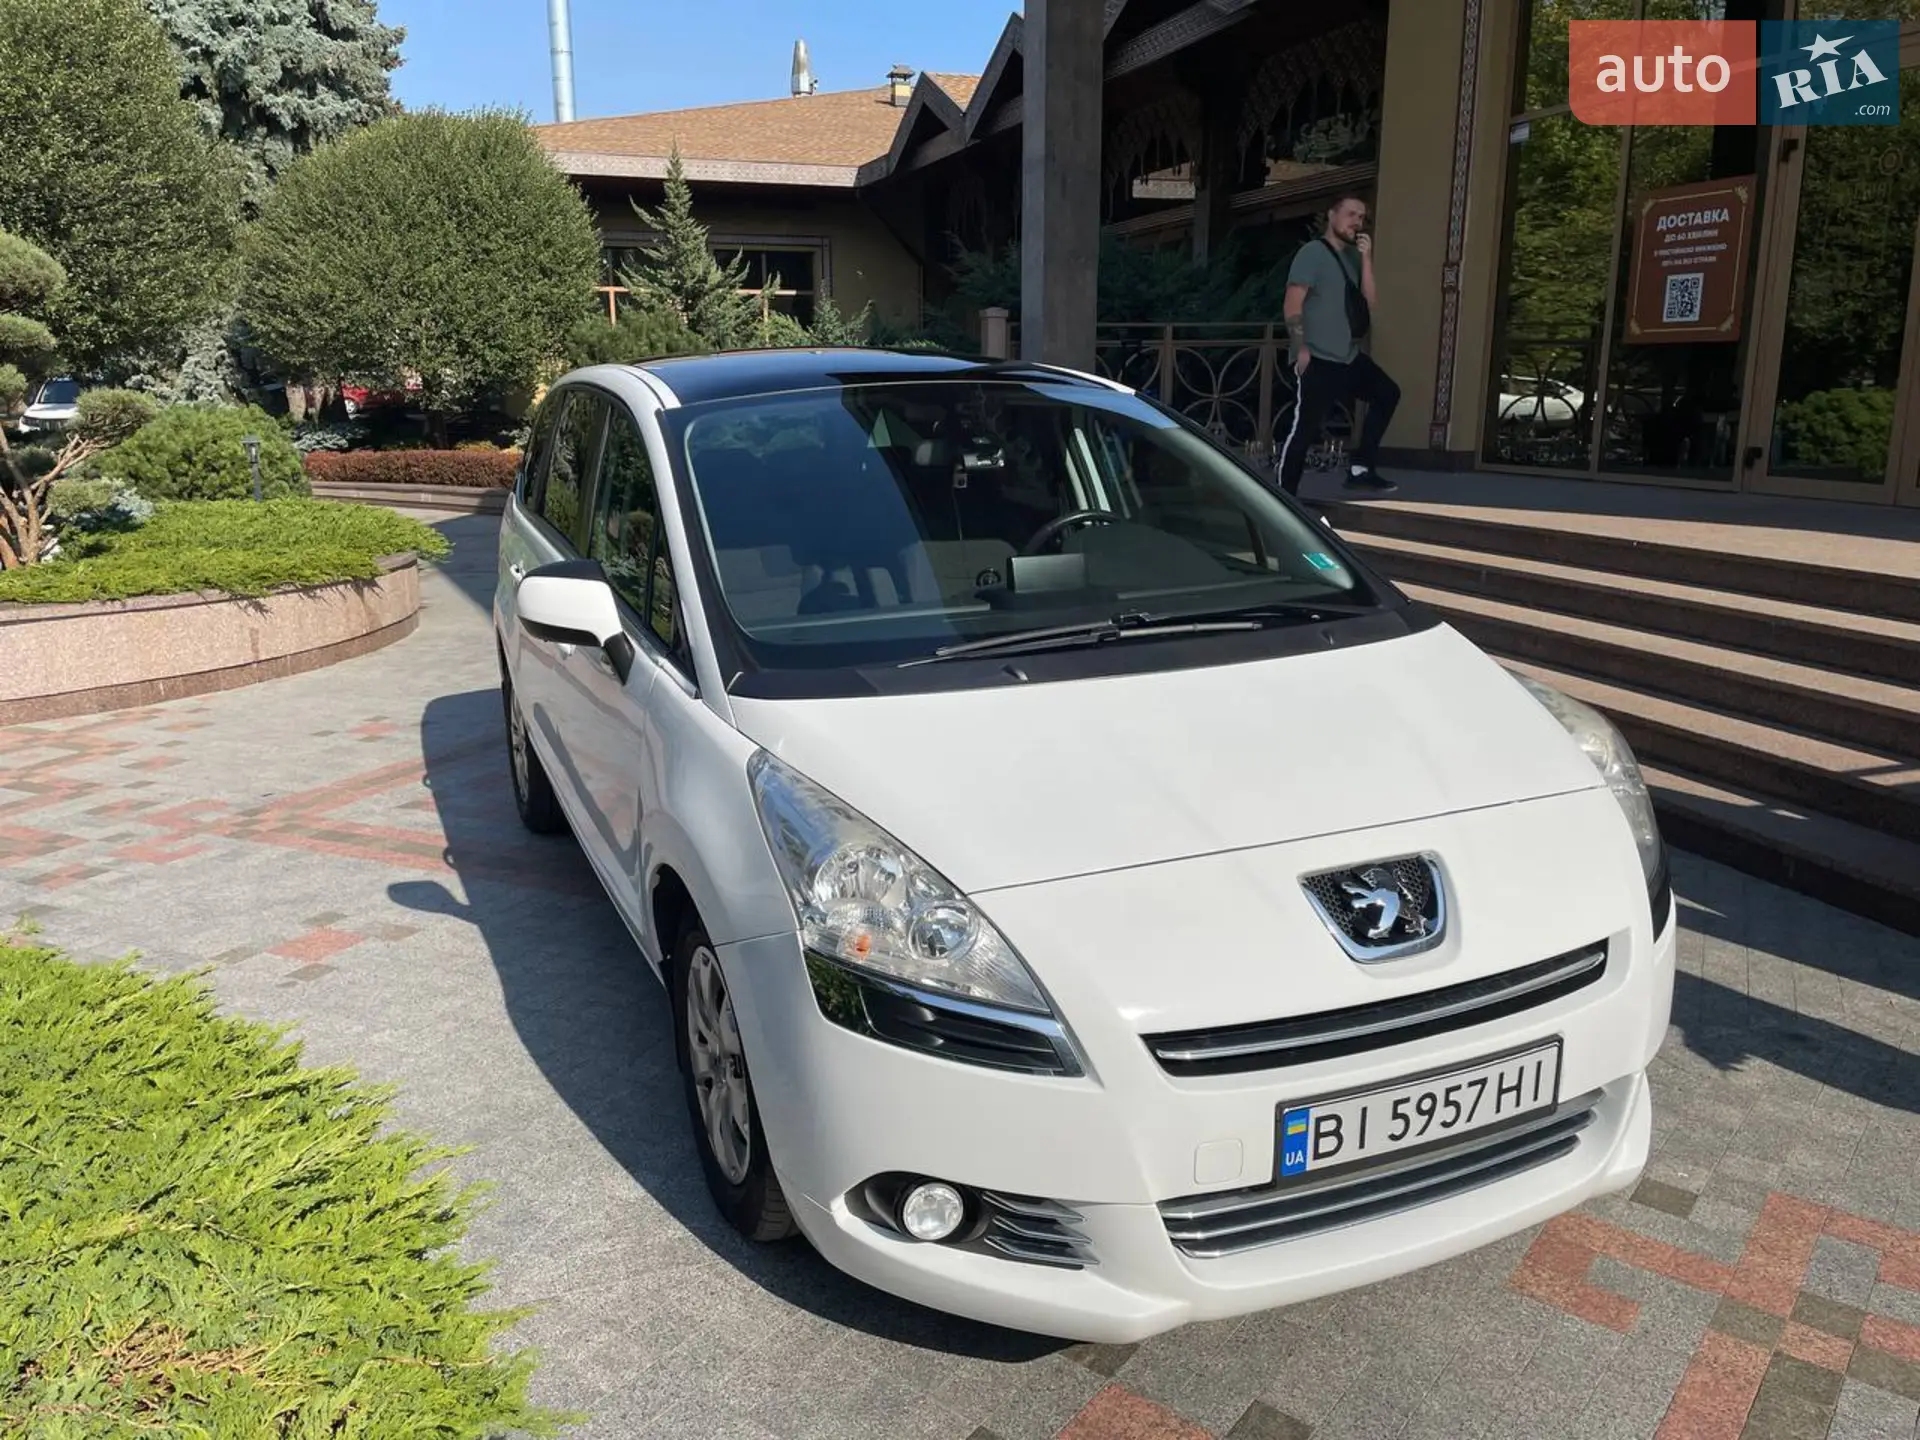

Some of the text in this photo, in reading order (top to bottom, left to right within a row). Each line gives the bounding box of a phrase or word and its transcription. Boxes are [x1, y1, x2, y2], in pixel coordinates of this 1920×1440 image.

[1657, 208, 1729, 231] ДОСТАВКА
[1312, 1060, 1543, 1161] BI 5957 HI
[1284, 1149, 1305, 1168] UA
